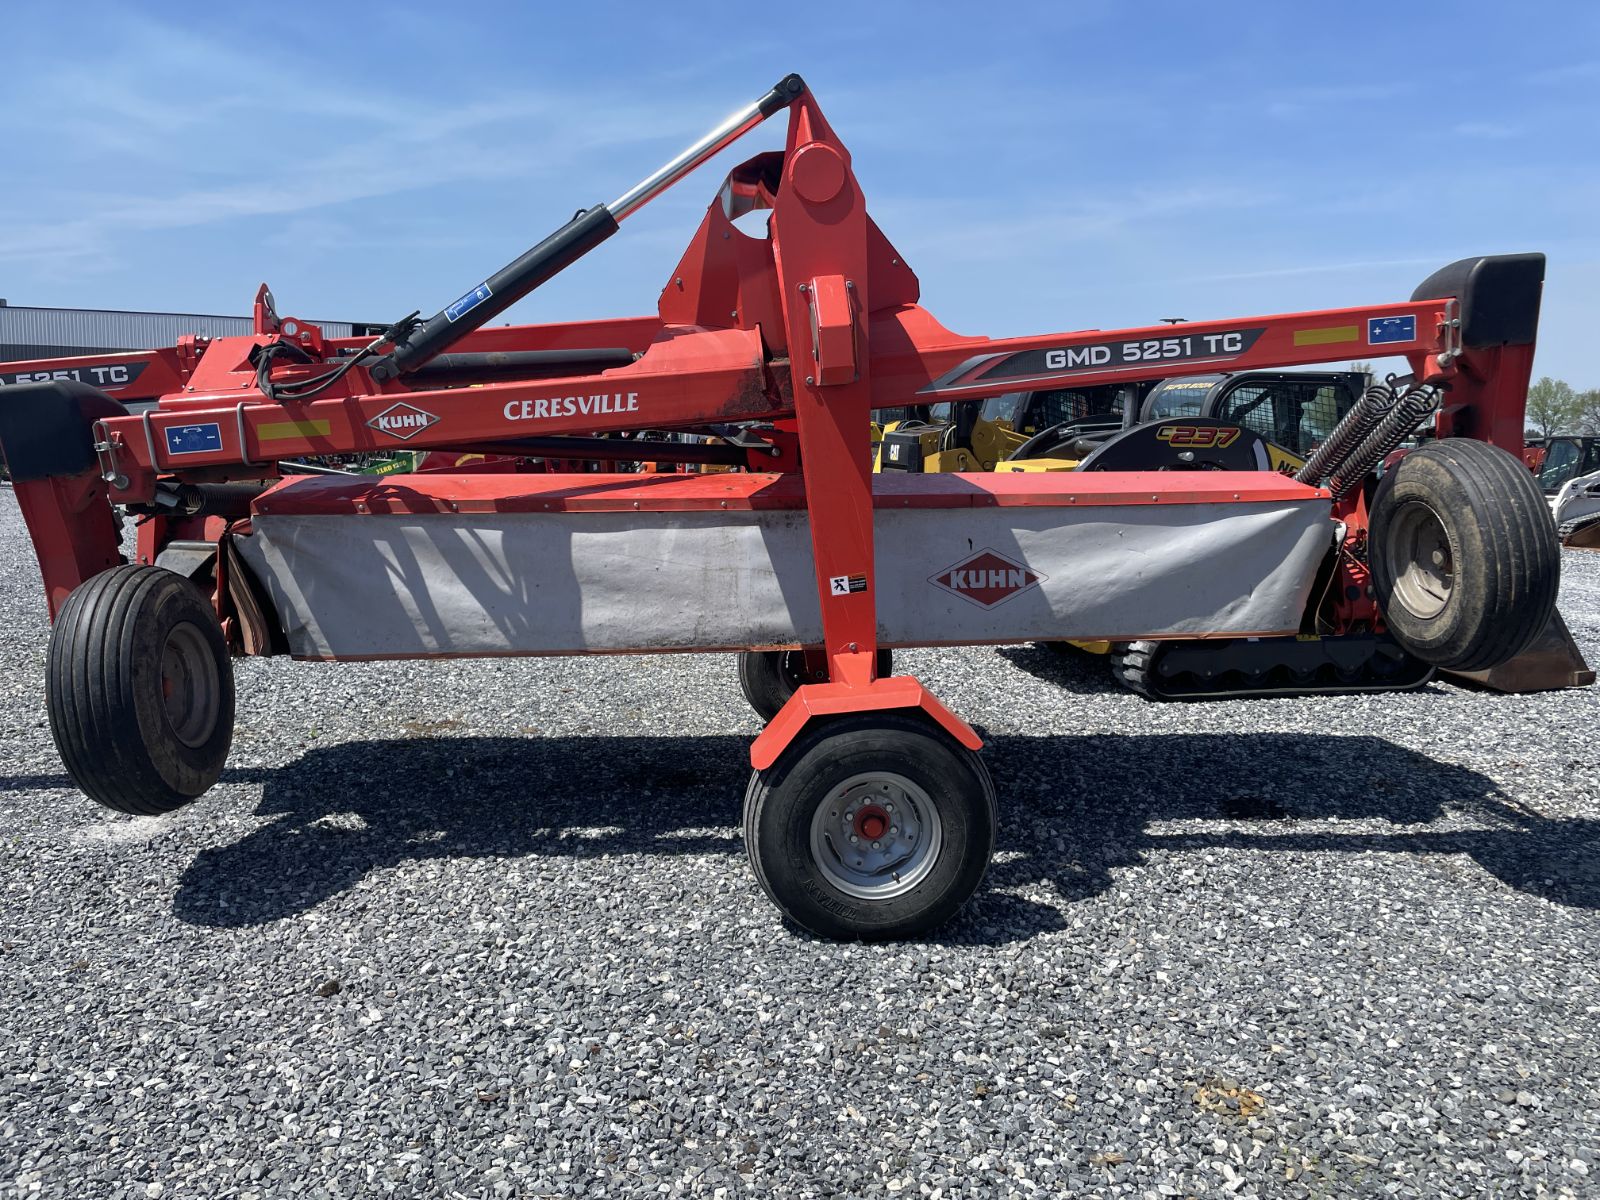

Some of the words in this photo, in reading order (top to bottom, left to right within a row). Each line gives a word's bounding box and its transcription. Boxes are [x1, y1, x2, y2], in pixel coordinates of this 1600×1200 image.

[1045, 346, 1111, 369] GMD
[1122, 337, 1192, 361] 5251
[1203, 332, 1242, 353] TC
[90, 365, 129, 384] TC
[503, 392, 640, 421] CERESVILLE
[378, 413, 428, 430] KUHN
[950, 568, 1026, 590] KUHN
